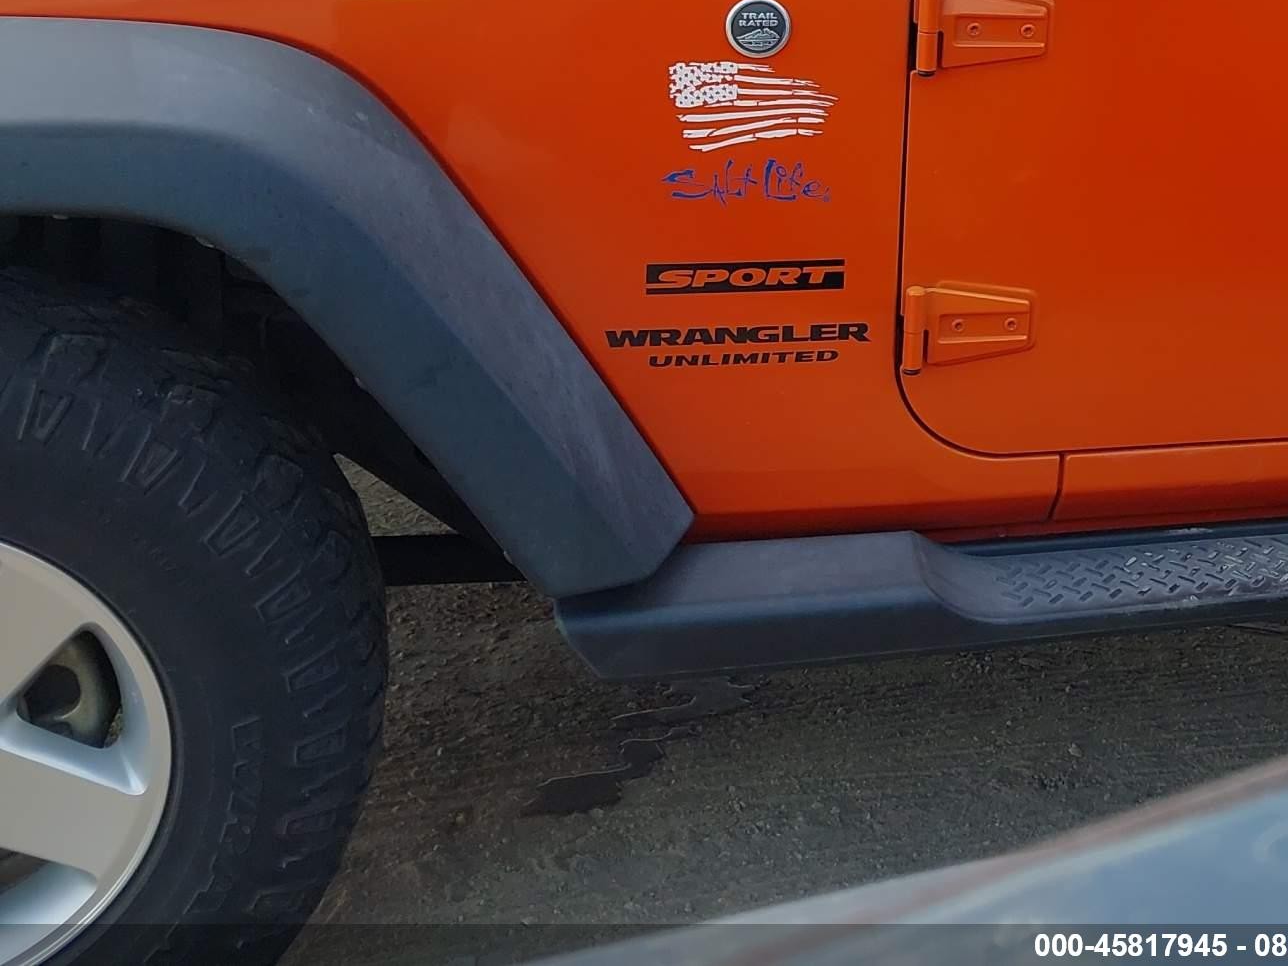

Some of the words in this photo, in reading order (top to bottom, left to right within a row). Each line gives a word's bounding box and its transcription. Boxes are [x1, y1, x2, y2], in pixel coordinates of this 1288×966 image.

[738, 19, 779, 27] RATED
[741, 12, 778, 20] TRAIL
[646, 264, 845, 289] SPORT
[605, 323, 872, 347] WRANGLER
[649, 350, 840, 368] UNLIMITED
